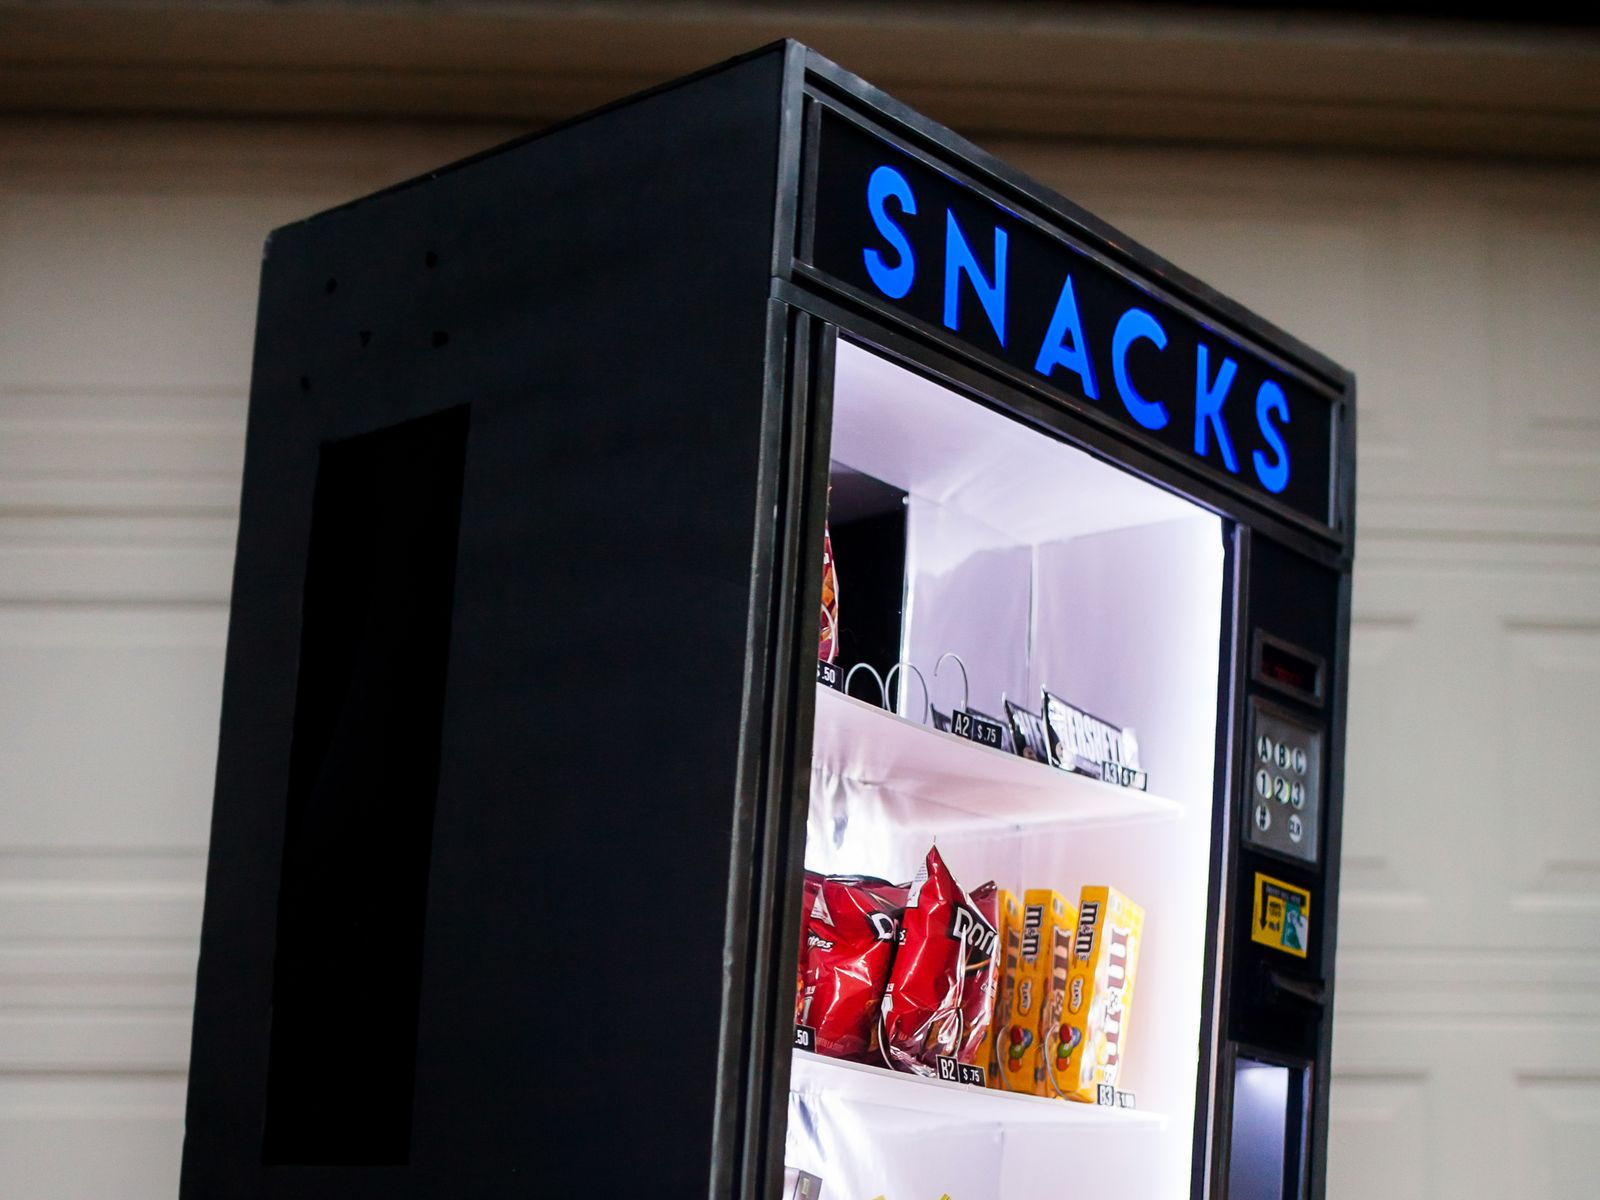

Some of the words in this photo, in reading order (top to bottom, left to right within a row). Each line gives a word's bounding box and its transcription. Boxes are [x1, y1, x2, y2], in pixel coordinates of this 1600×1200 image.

[863, 166, 1290, 494] SNACKS
[954, 713, 970, 738] A2
[1261, 735, 1268, 760] A
[1279, 744, 1286, 768] B
[1296, 750, 1302, 774] C
[1104, 762, 1118, 784] A3
[1276, 778, 1284, 802] 2
[1293, 782, 1300, 806] 3
[940, 1058, 956, 1080] B2
